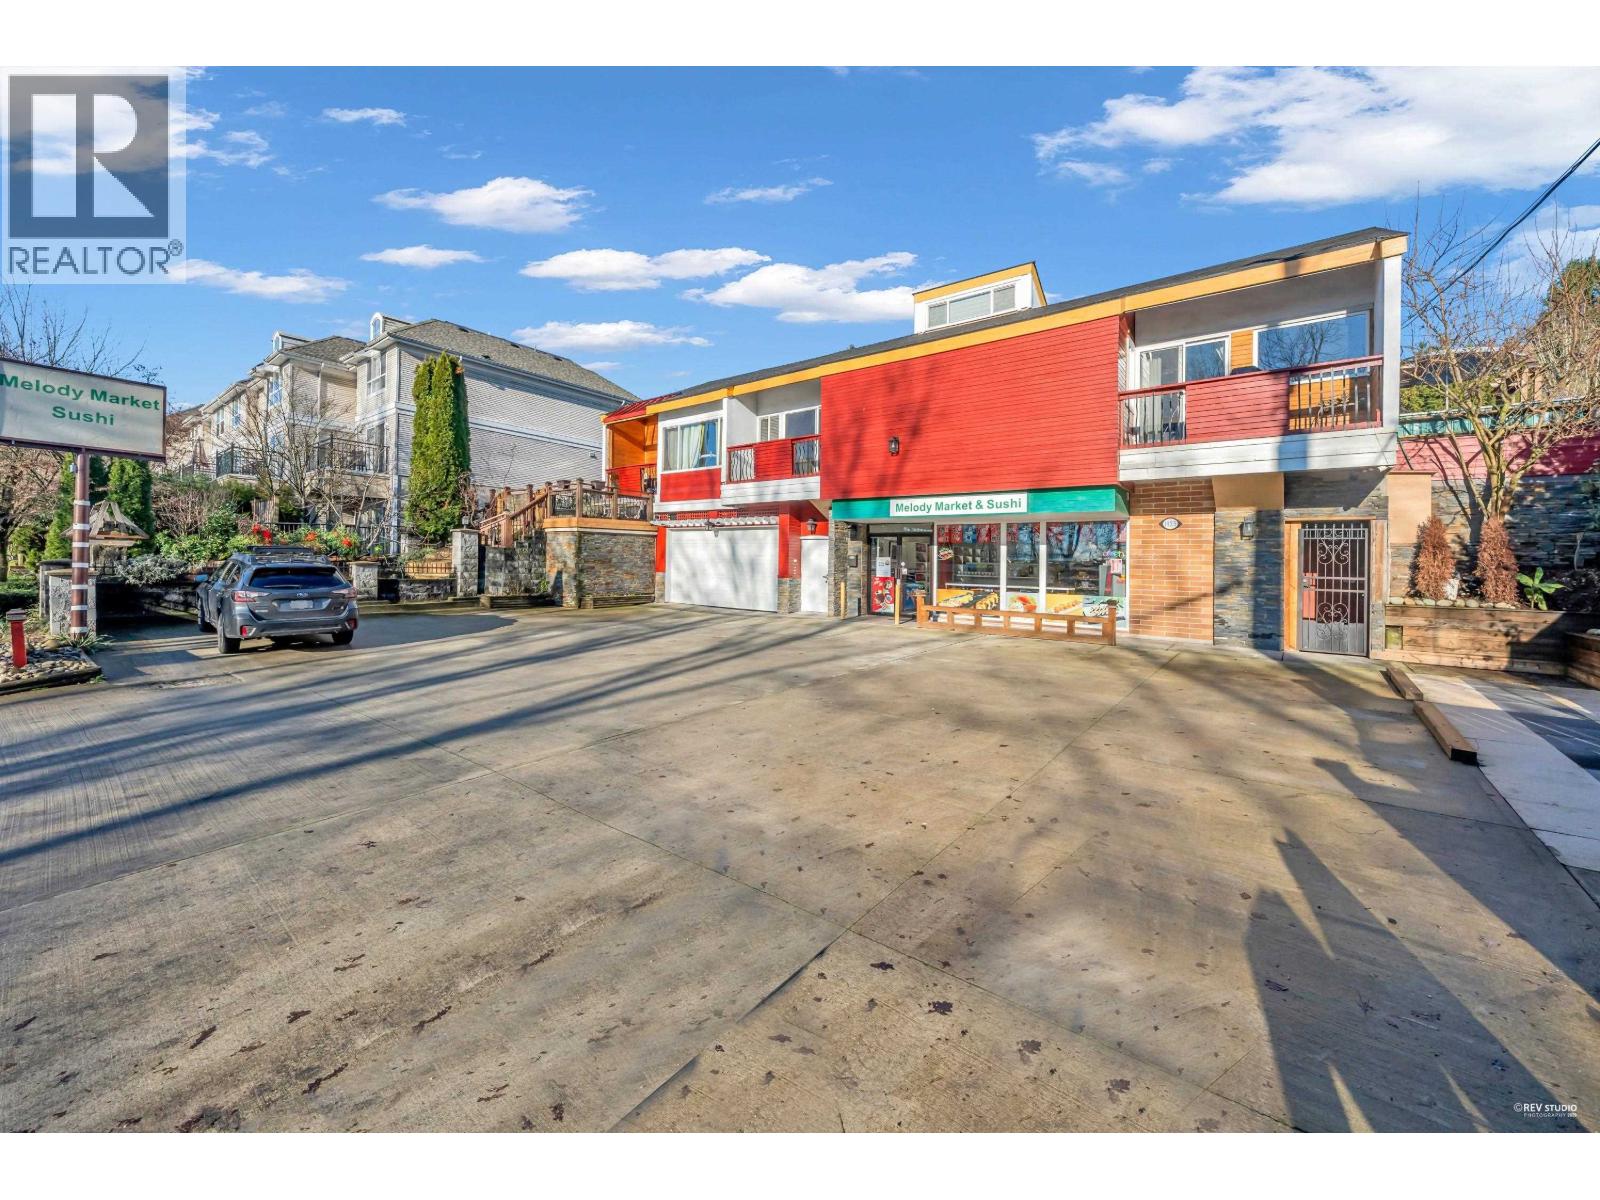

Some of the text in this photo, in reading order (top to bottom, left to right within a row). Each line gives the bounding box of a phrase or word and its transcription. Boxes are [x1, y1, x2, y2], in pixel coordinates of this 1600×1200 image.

[0, 374, 161, 411] Melody Market
[52, 406, 115, 426] Sushi
[895, 498, 1022, 513] Melody Market & Sushi
